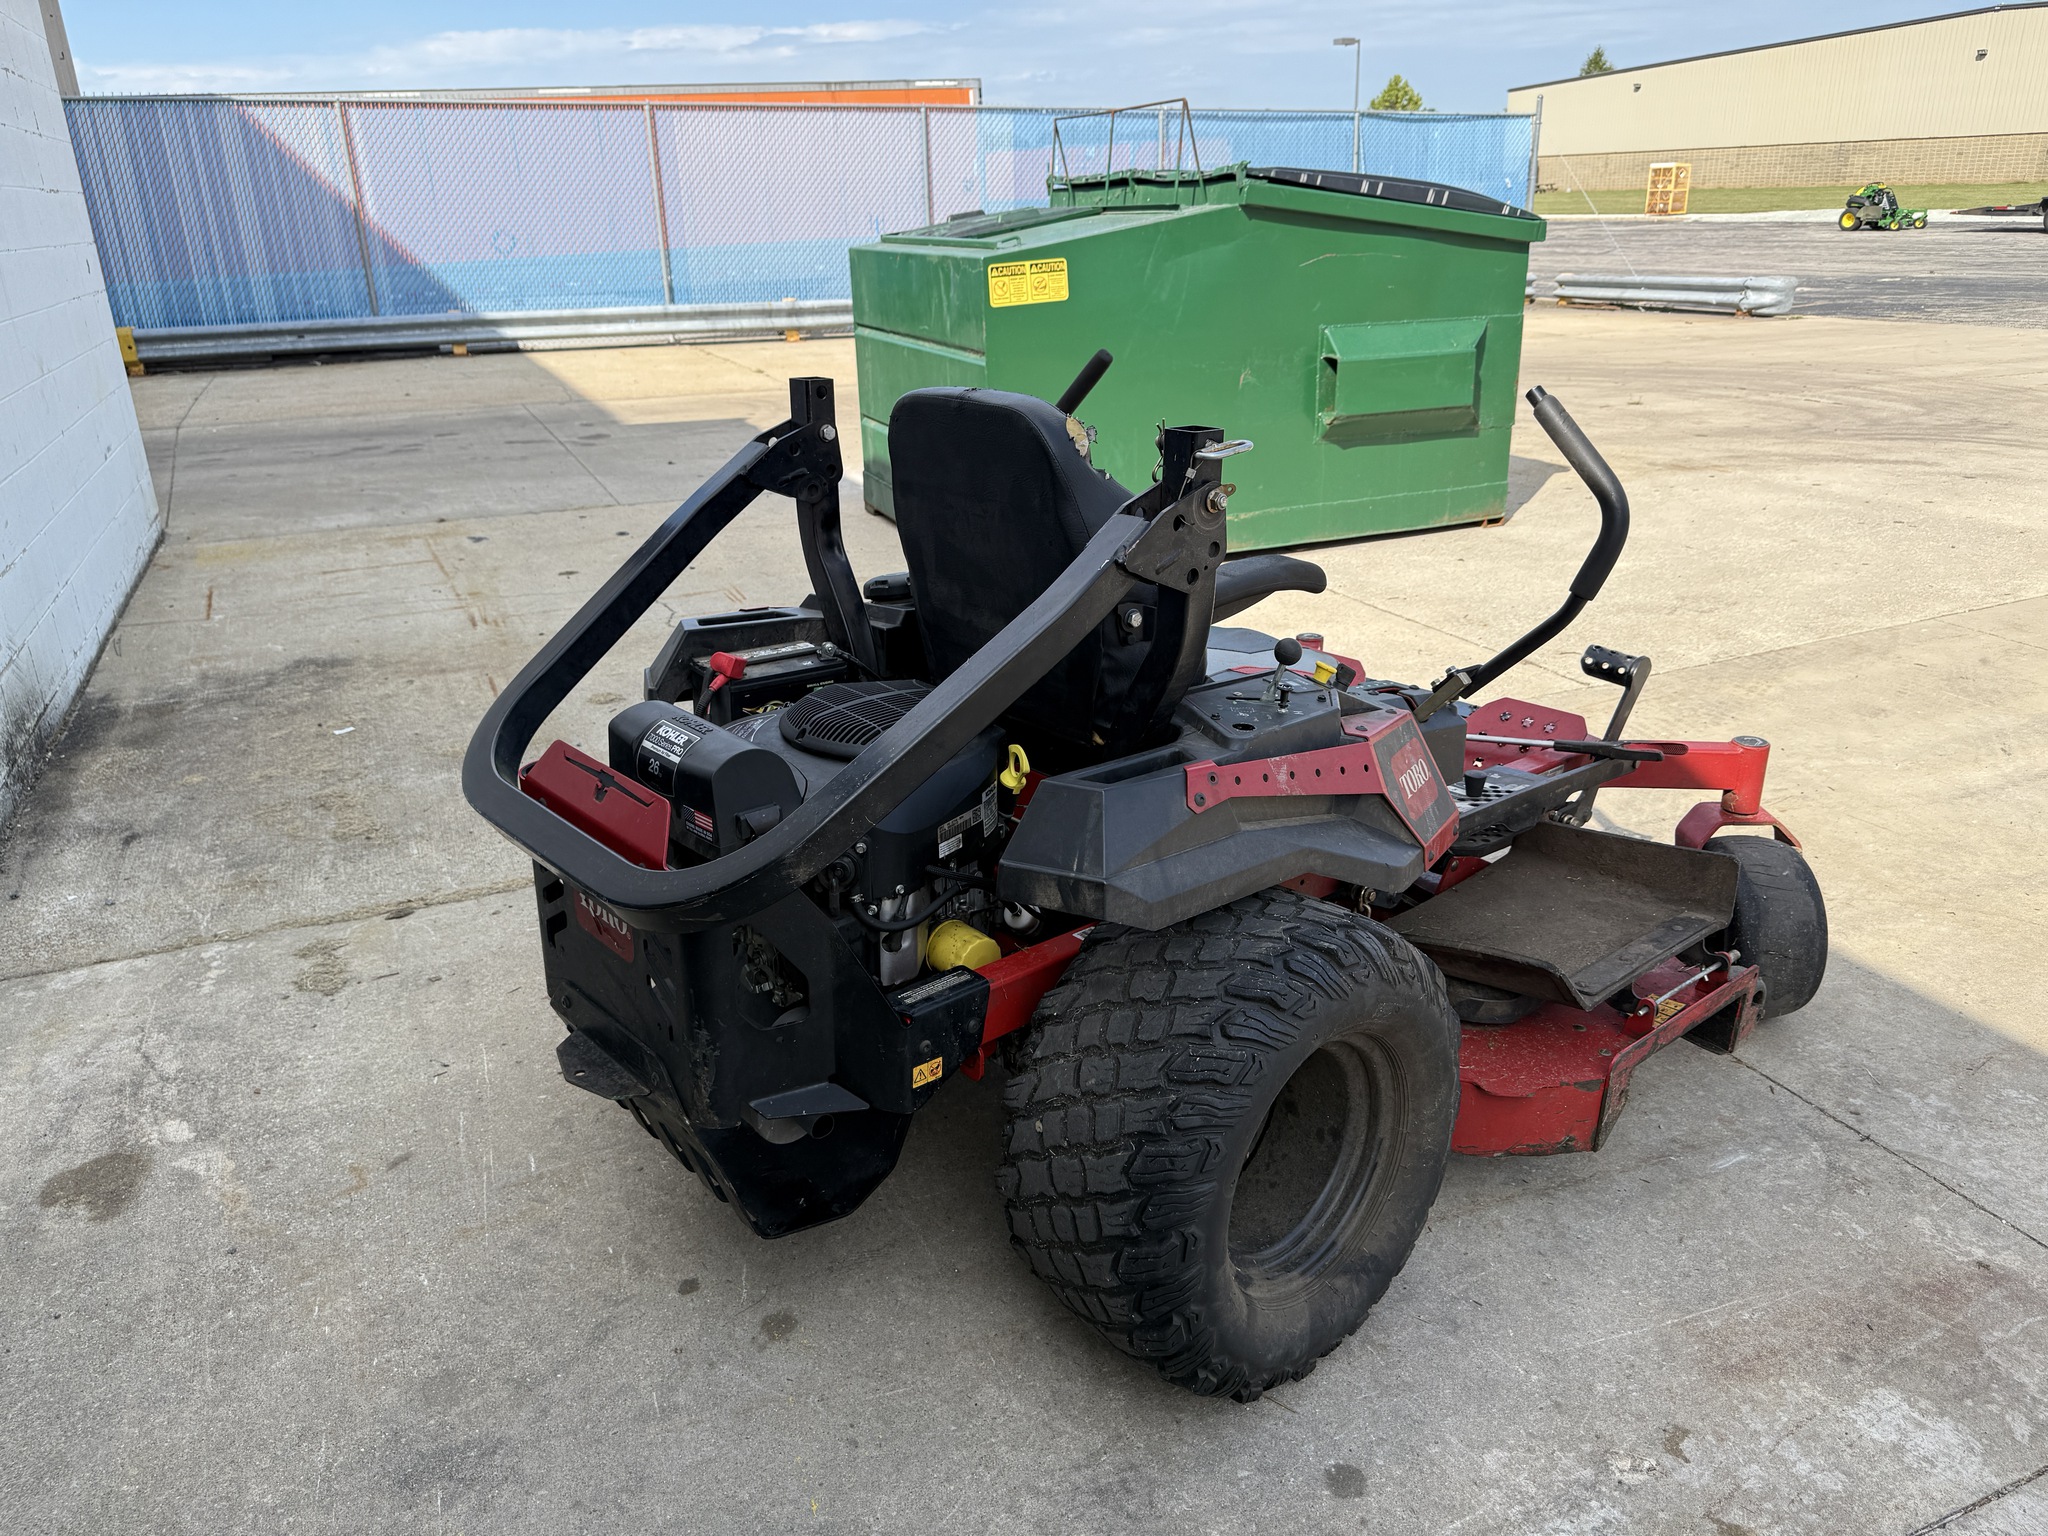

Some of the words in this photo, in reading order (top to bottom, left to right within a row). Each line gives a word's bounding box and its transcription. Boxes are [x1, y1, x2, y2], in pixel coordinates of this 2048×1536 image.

[998, 266, 1026, 276] CAUTION
[1037, 262, 1065, 272] CAUTION
[647, 733, 660, 743] 7000
[657, 738, 673, 751] Series
[671, 745, 684, 756] PRO
[656, 725, 688, 746] KOHLER
[648, 758, 660, 775] 26
[1399, 758, 1429, 799] TORO
